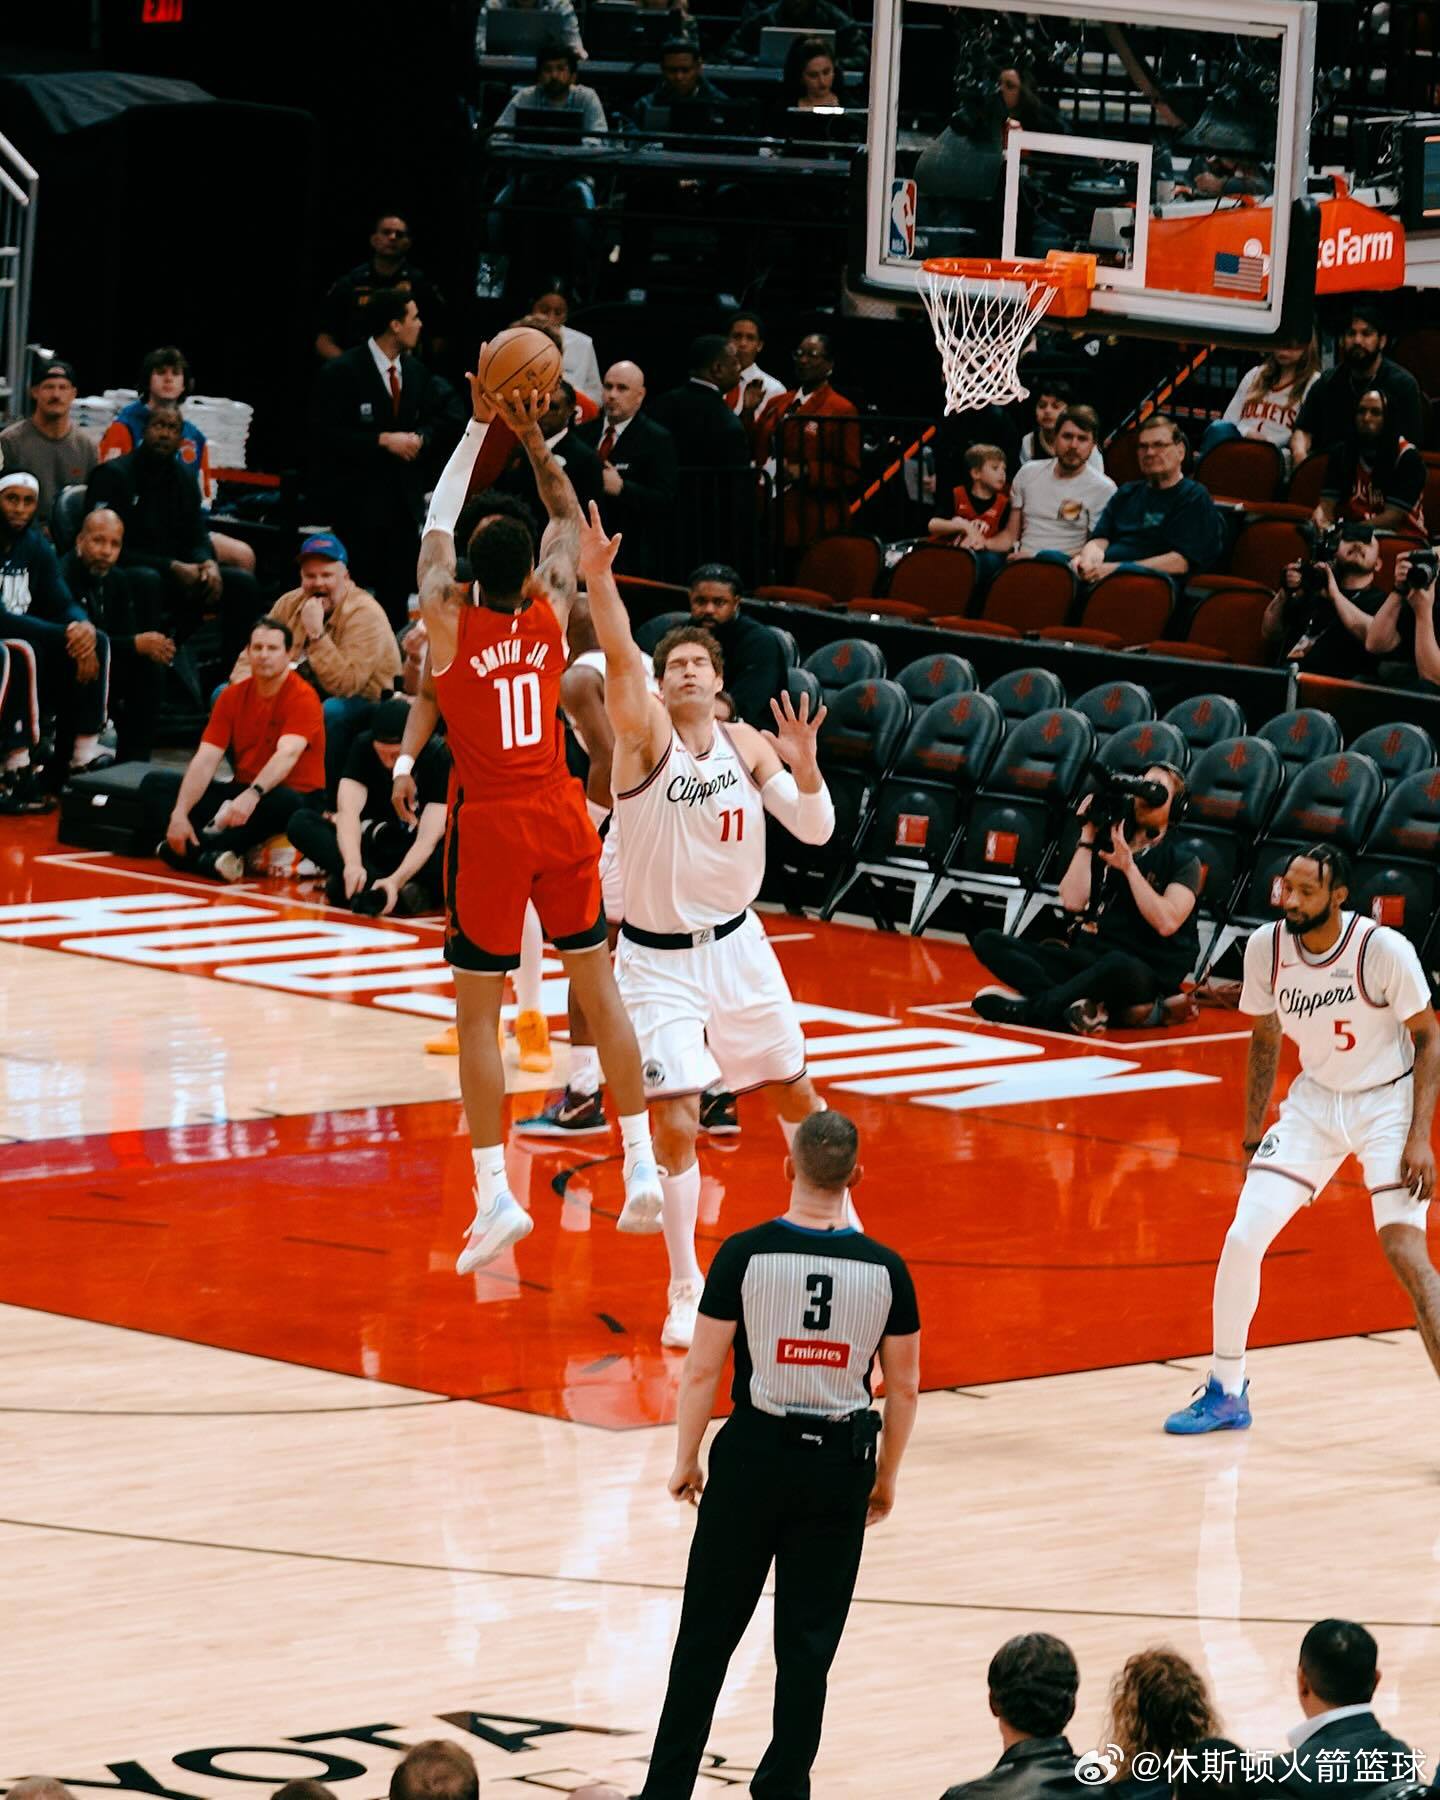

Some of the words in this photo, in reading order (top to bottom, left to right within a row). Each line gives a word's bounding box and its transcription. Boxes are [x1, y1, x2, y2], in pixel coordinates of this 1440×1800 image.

[470, 638, 522, 678] SMITH
[493, 671, 543, 750] 10
[666, 769, 739, 808] Clippers
[718, 808, 744, 842] 11
[1279, 985, 1358, 1019] Clippers
[1333, 1019, 1357, 1052] 5
[803, 1273, 834, 1331] 3
[783, 1343, 842, 1363] Emirates
